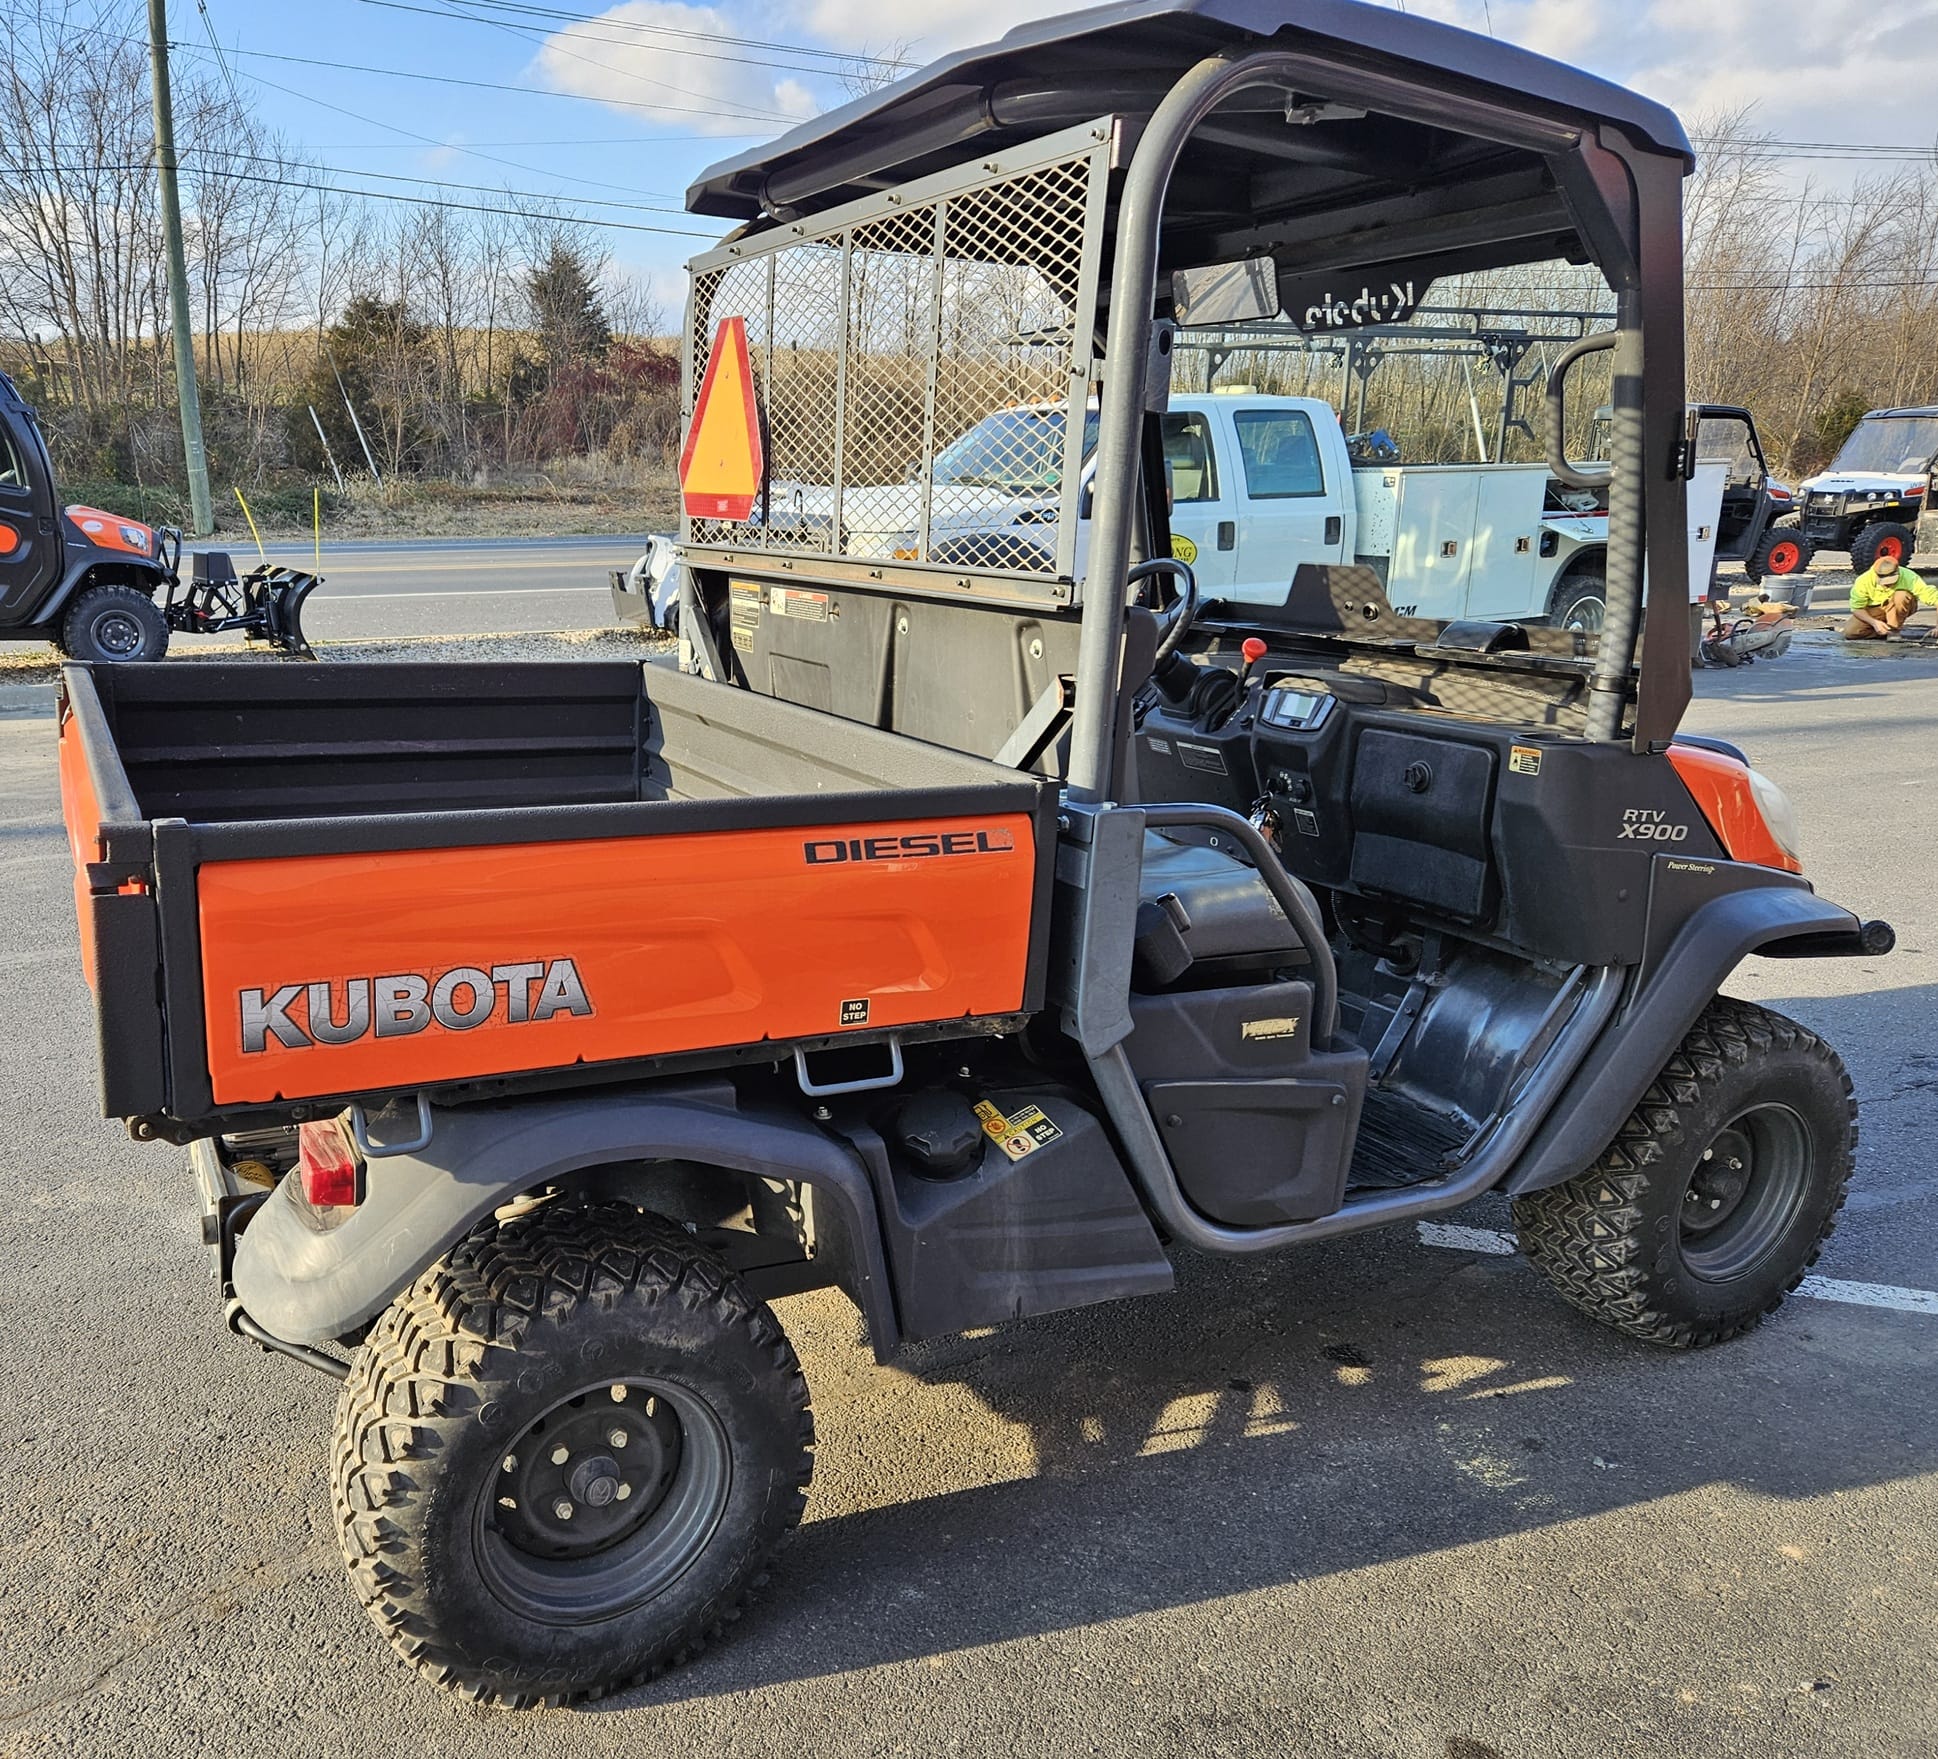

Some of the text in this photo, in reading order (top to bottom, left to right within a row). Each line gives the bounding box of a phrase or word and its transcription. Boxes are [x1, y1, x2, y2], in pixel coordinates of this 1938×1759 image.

[1623, 809, 1666, 823] RTV
[1617, 823, 1689, 841] X900
[804, 830, 1013, 864] DIESEL
[1667, 861, 1716, 875] Power Steering
[239, 958, 593, 1053] KUBOTA
[849, 1002, 863, 1011] NO
[843, 1011, 867, 1021] STEP
[1034, 1124, 1047, 1134] NO
[1035, 1127, 1055, 1141] STEP
